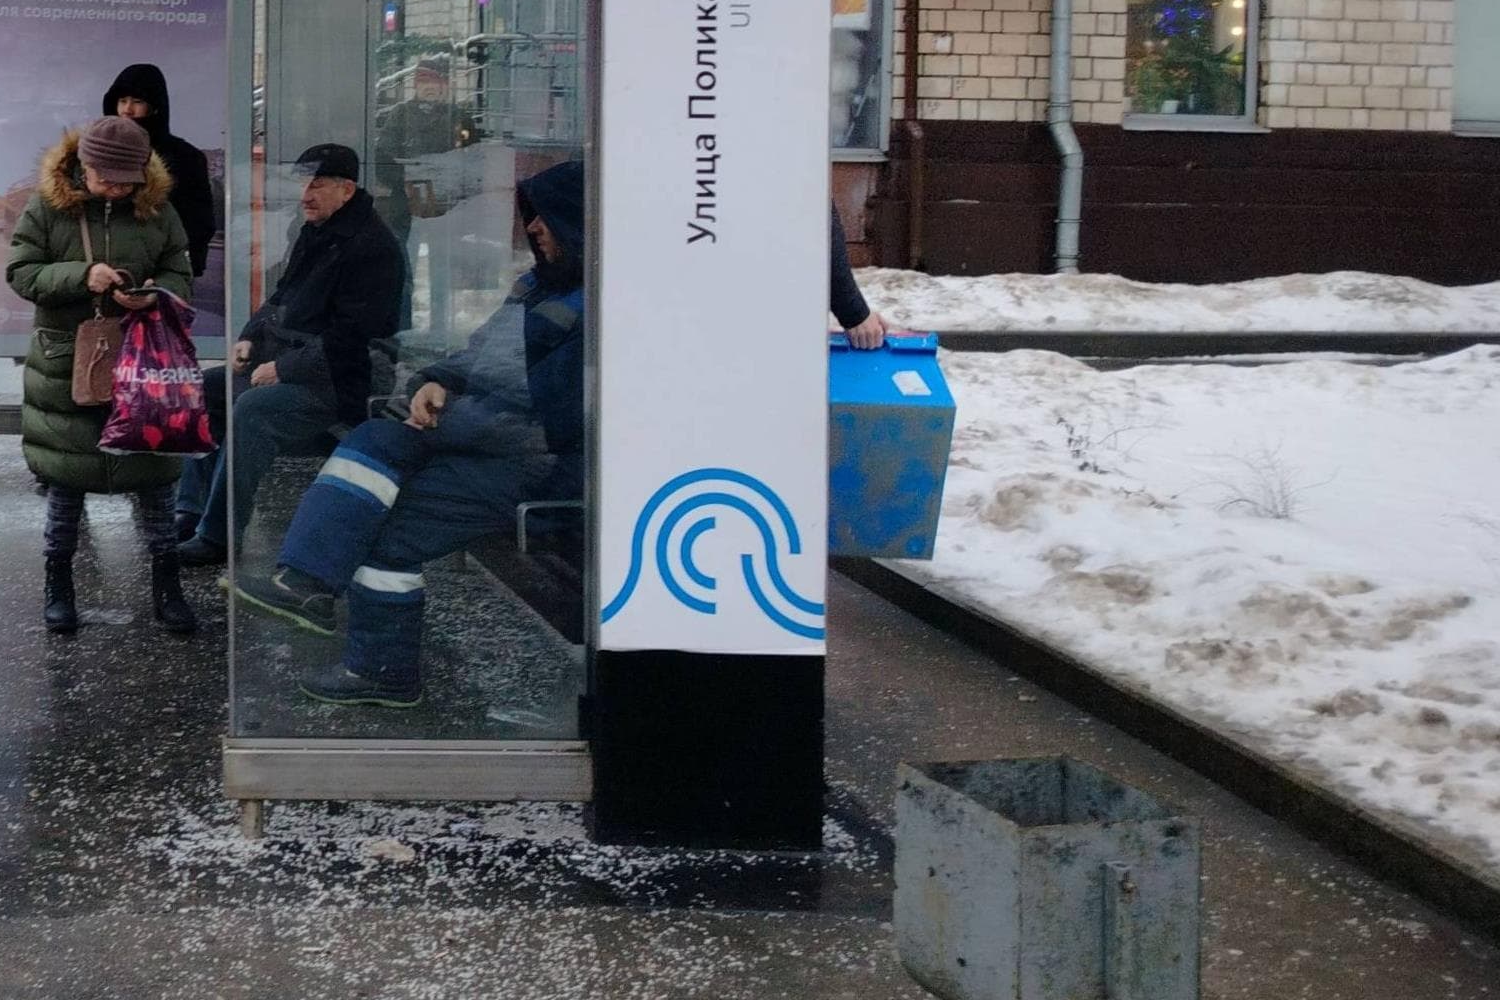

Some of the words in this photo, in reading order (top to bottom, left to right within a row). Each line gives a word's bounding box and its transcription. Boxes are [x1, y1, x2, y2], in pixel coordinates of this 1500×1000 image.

[23, 5, 145, 23] современного
[148, 10, 208, 25] города
[686, 132, 722, 245] Улица
